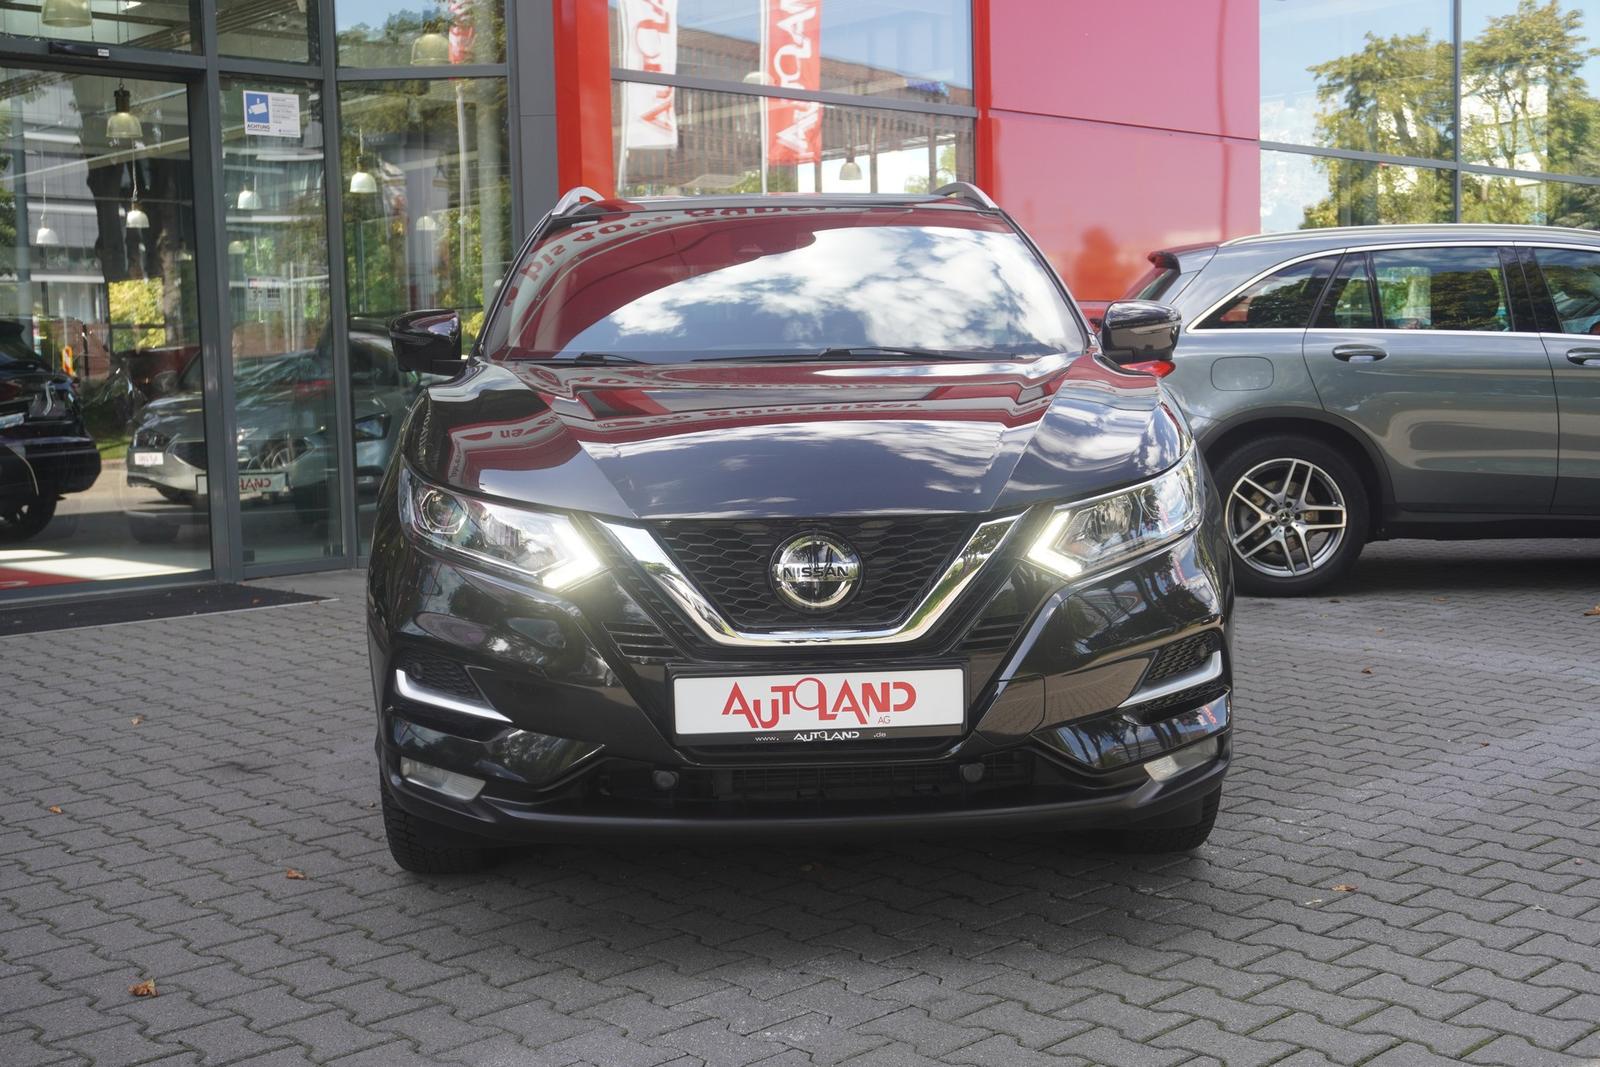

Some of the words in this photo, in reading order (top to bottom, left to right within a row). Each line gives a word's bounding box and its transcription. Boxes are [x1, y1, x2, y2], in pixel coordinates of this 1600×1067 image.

[783, 566, 848, 578] NISSAN
[722, 677, 917, 729] AUTOLAND
[878, 716, 891, 725] AG
[793, 730, 860, 742] AUTOLAND
